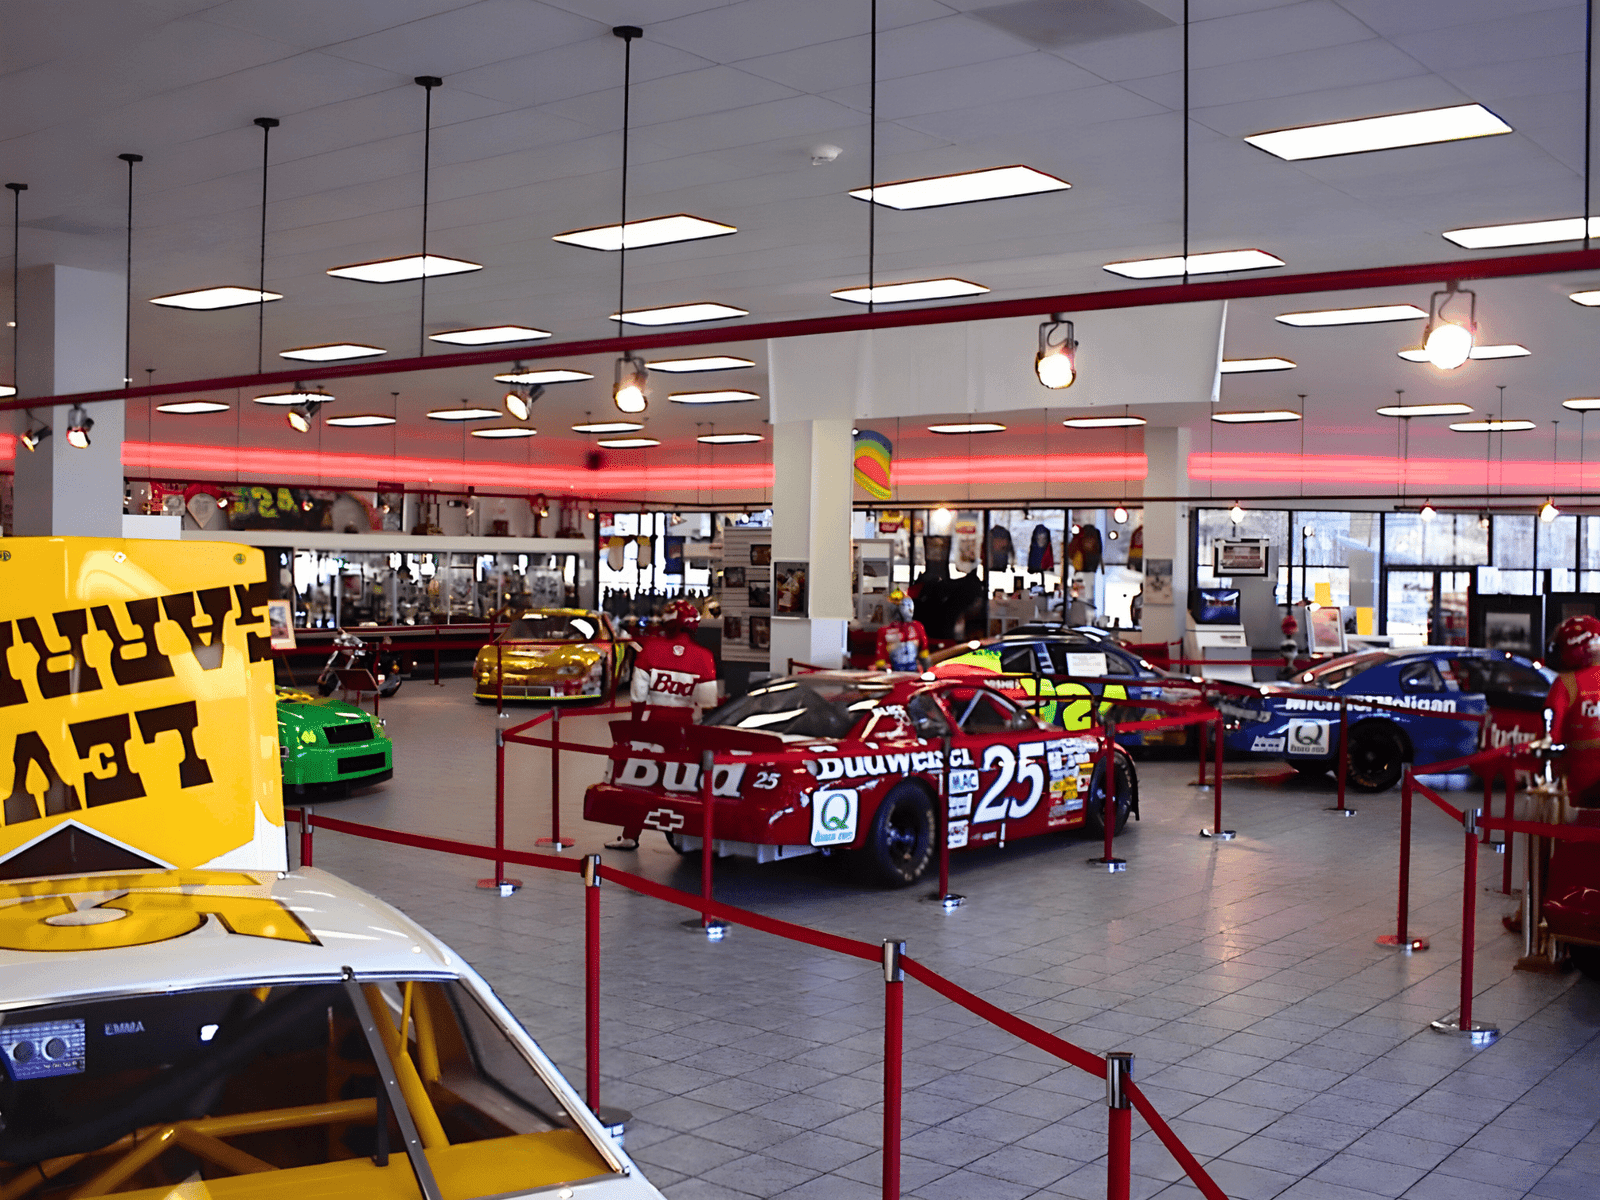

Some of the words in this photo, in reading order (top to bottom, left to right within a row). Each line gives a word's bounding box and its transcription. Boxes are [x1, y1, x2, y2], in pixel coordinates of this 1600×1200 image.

[651, 672, 700, 697] Bud
[1295, 720, 1323, 746] Q
[0, 700, 213, 827] LEV
[614, 741, 747, 797] Bud
[753, 771, 781, 789] 25
[972, 741, 1045, 825] 25
[821, 793, 850, 831] Q
